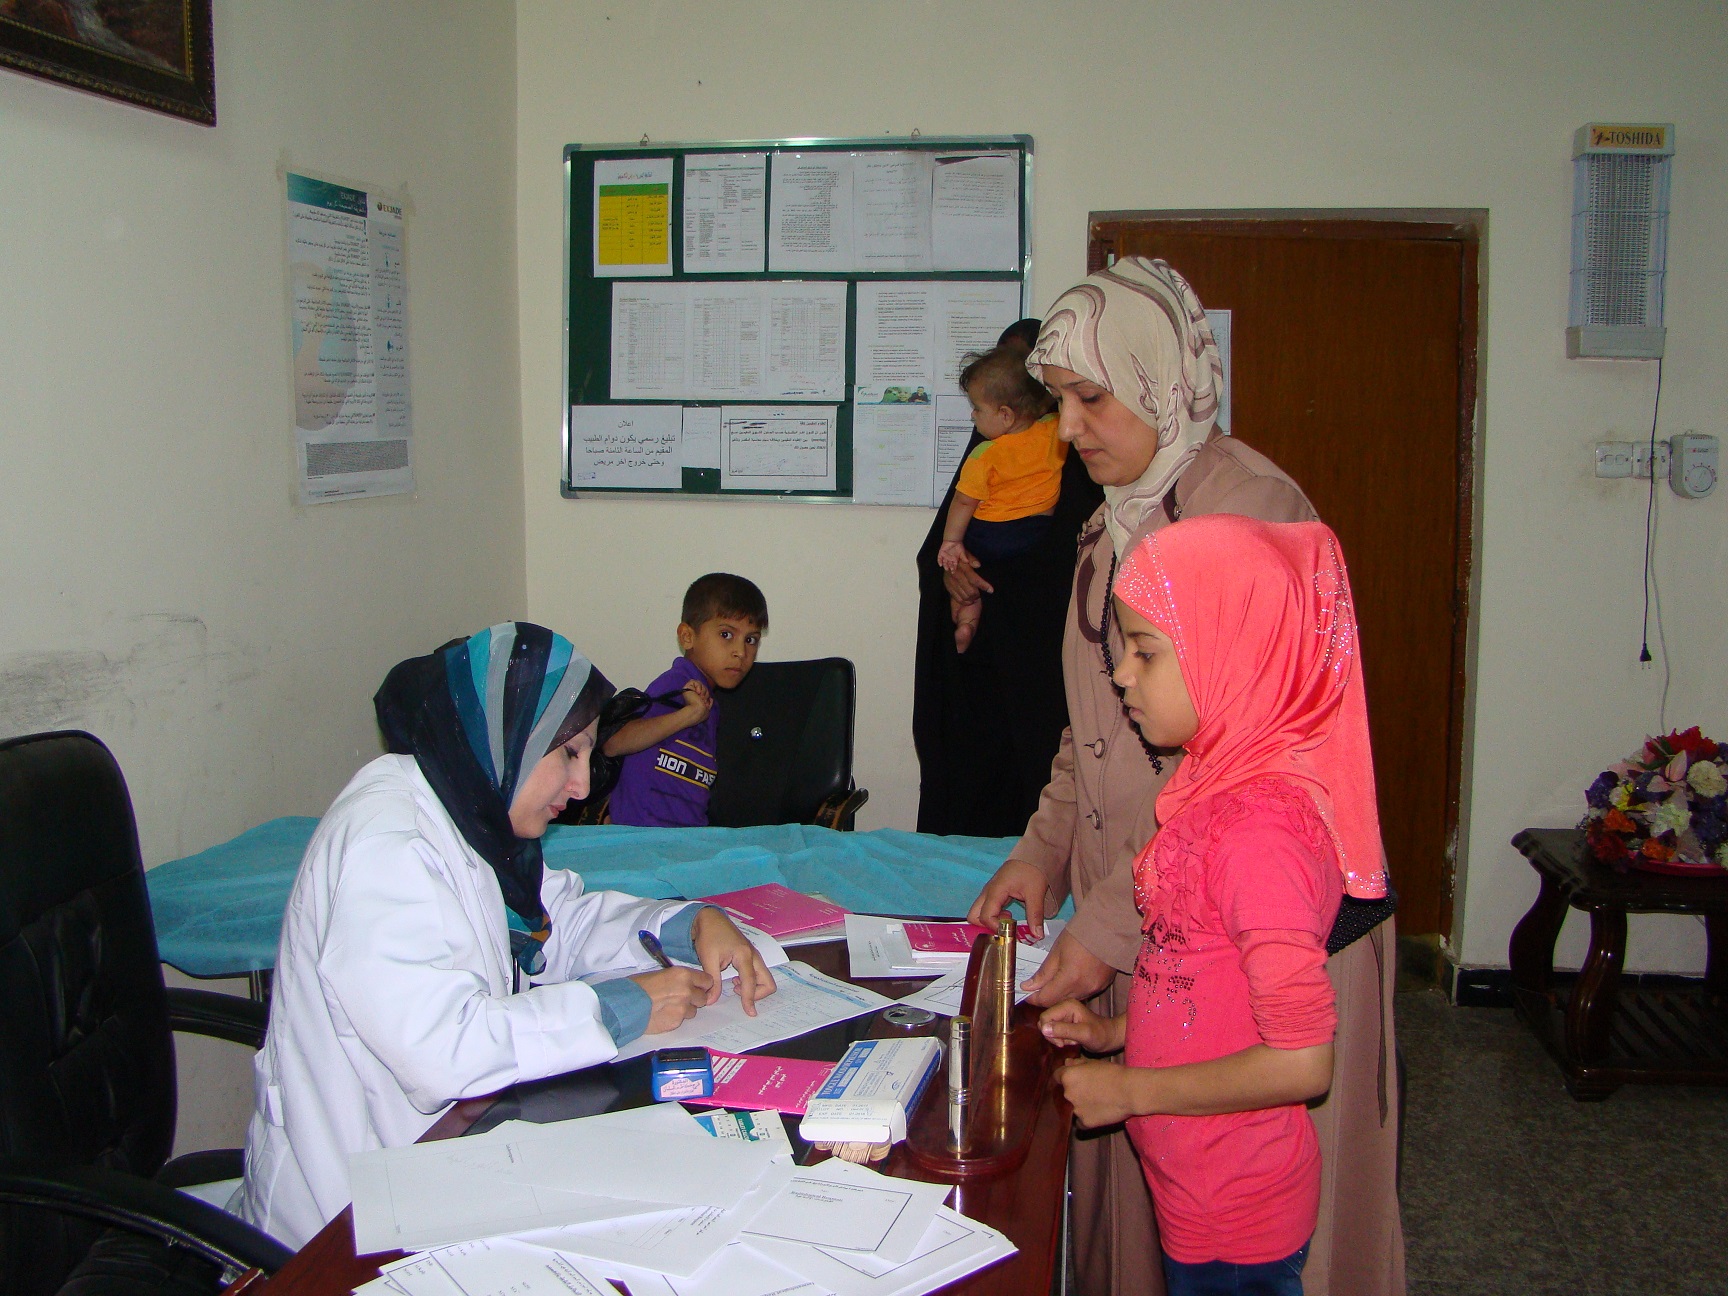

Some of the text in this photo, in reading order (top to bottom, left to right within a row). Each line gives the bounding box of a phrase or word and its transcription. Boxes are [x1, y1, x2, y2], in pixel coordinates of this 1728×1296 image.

[1608, 131, 1661, 145] TOSHIDA
[618, 420, 633, 428] اعلان
[583, 434, 602, 442] الطبيب
[604, 434, 619, 444] دوام
[638, 436, 659, 444] رسمي
[661, 434, 676, 445] تبليغ
[655, 447, 673, 456] المقيم
[628, 459, 646, 467] خروج
[648, 459, 665, 467] وحتى
